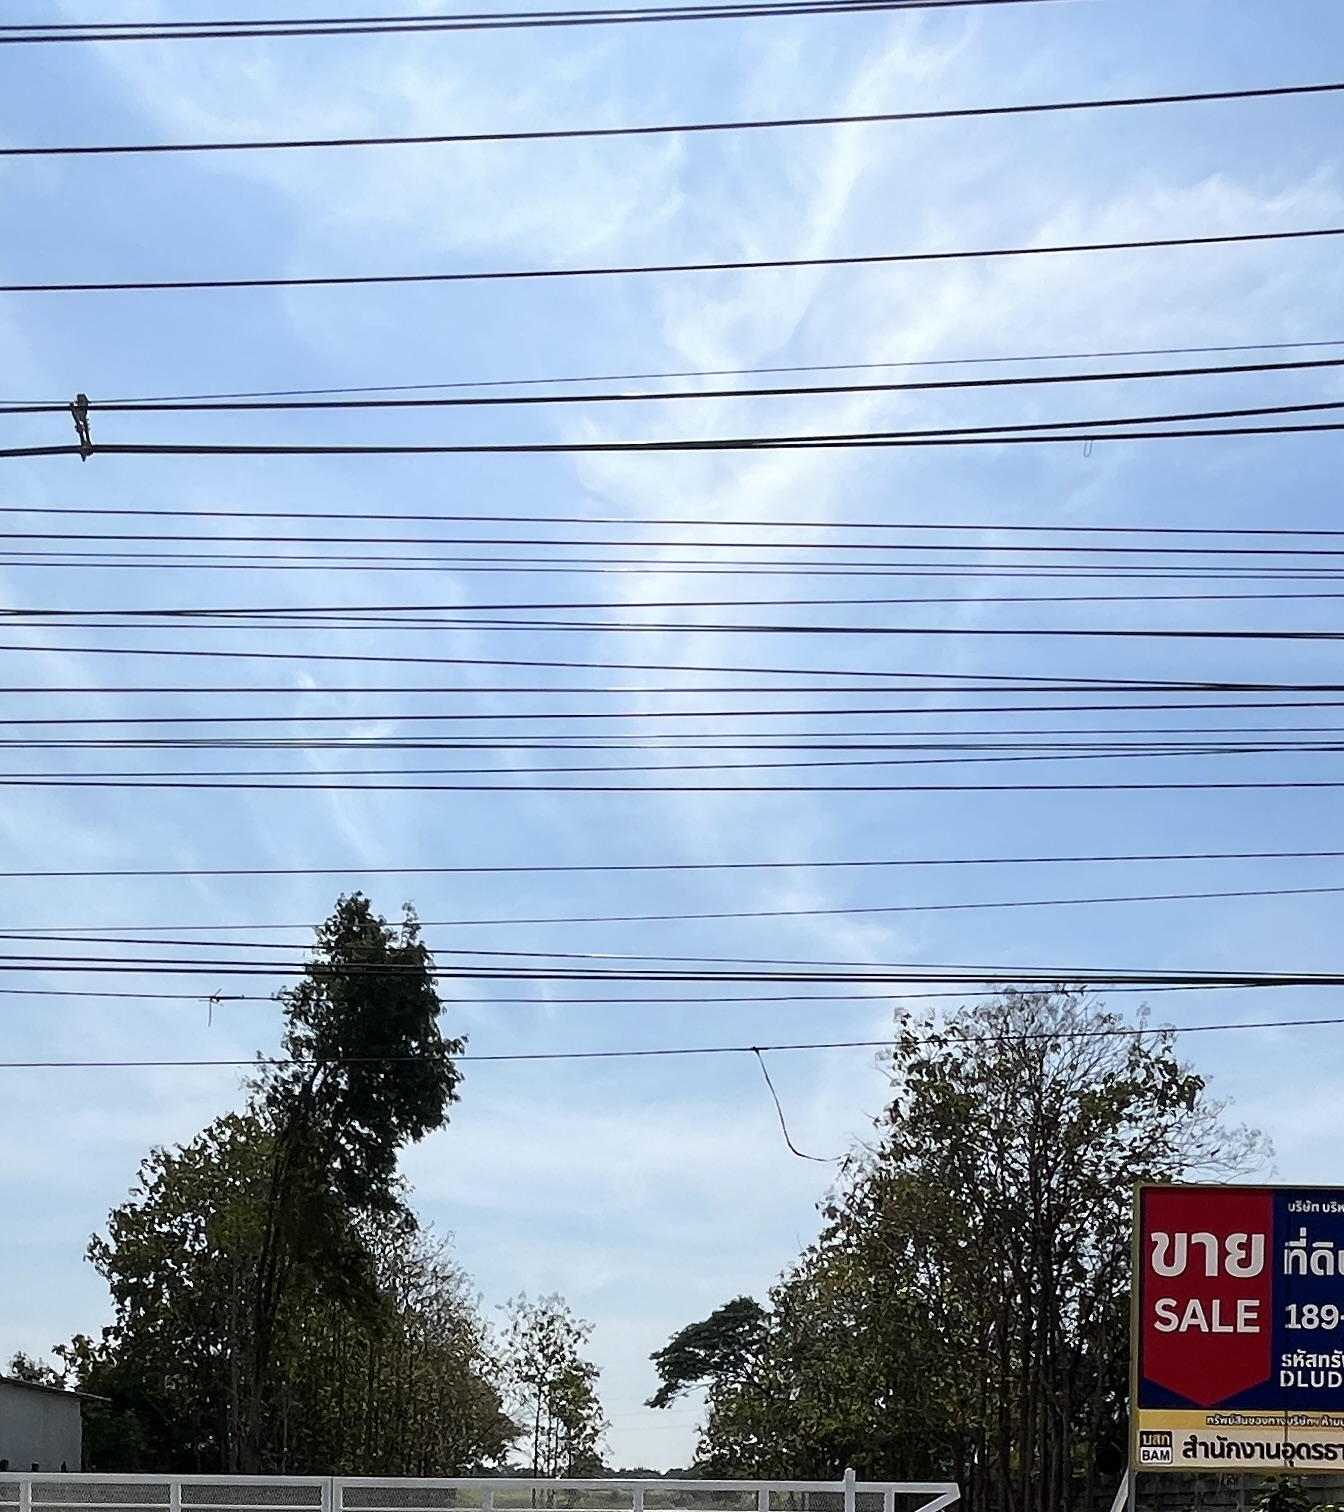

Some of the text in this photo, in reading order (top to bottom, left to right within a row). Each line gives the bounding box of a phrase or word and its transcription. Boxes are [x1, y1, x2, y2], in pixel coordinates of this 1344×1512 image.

[1287, 1200, 1320, 1213] บริษัท
[1150, 1231, 1265, 1278] ขาย
[1154, 1297, 1260, 1333] SALE
[1142, 1434, 1171, 1446] บสก
[1142, 1449, 1170, 1461] BAM
